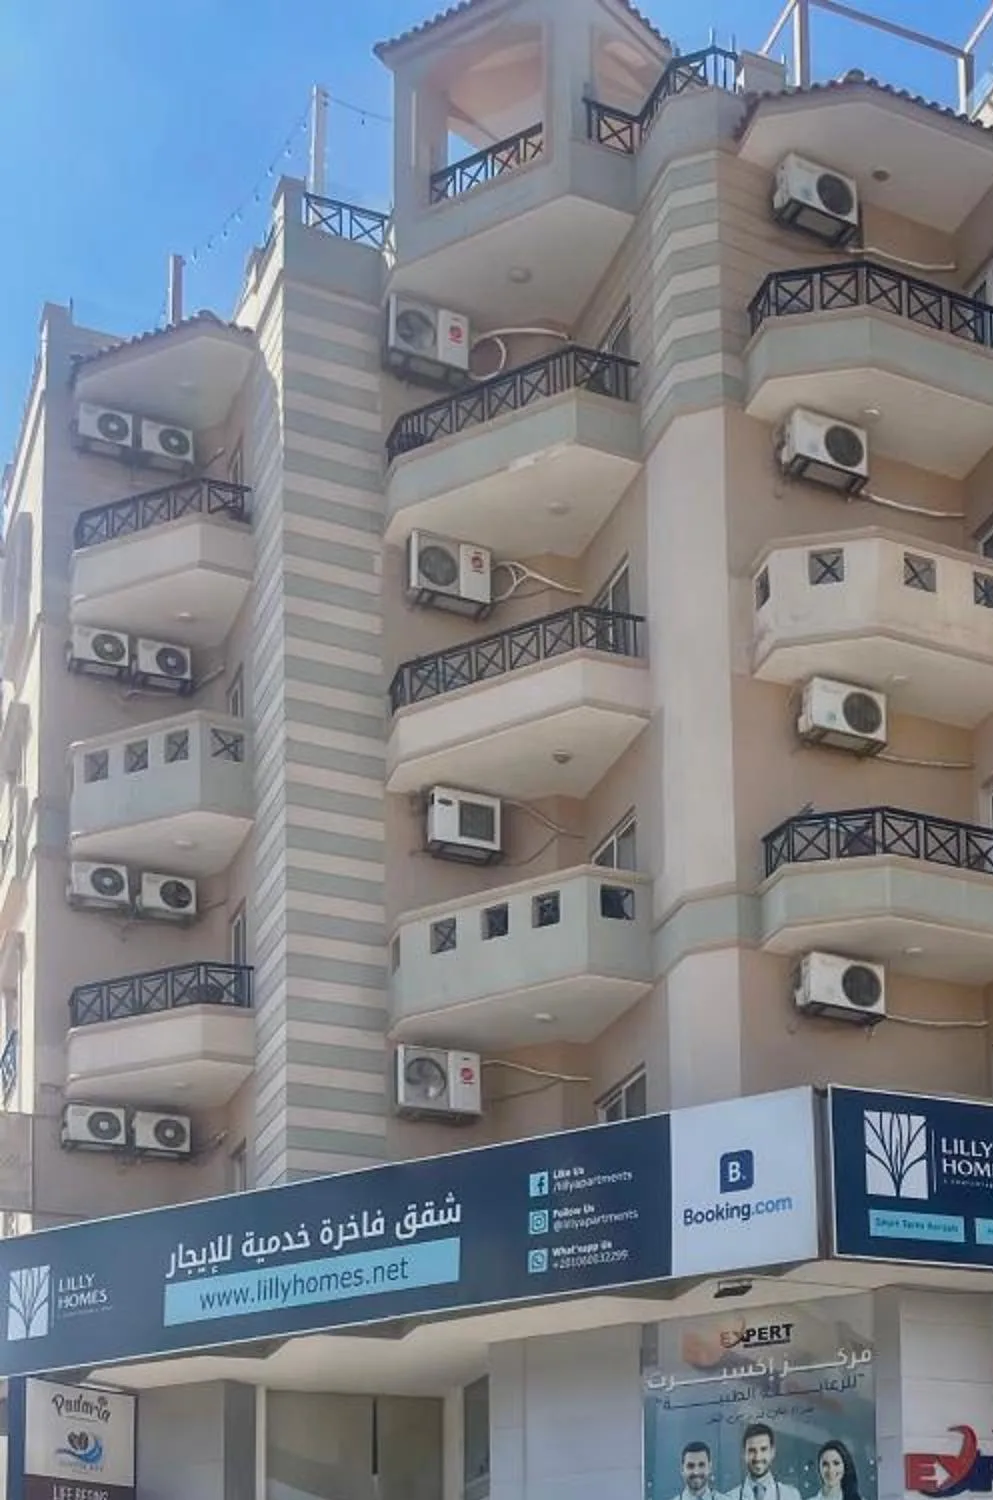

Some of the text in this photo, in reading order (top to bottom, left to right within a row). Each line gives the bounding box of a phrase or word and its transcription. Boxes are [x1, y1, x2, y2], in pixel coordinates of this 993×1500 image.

[941, 1137, 993, 1158] LILLY
[683, 1196, 793, 1227] Booking.com
[165, 1191, 462, 1279] شقق فاخرة خدمية للإيجار
[58, 1271, 96, 1293] LILLY
[199, 1258, 409, 1312] www.lillyhomes.net
[58, 1288, 108, 1309] HOMES
[52, 1393, 112, 1424] Padaria
